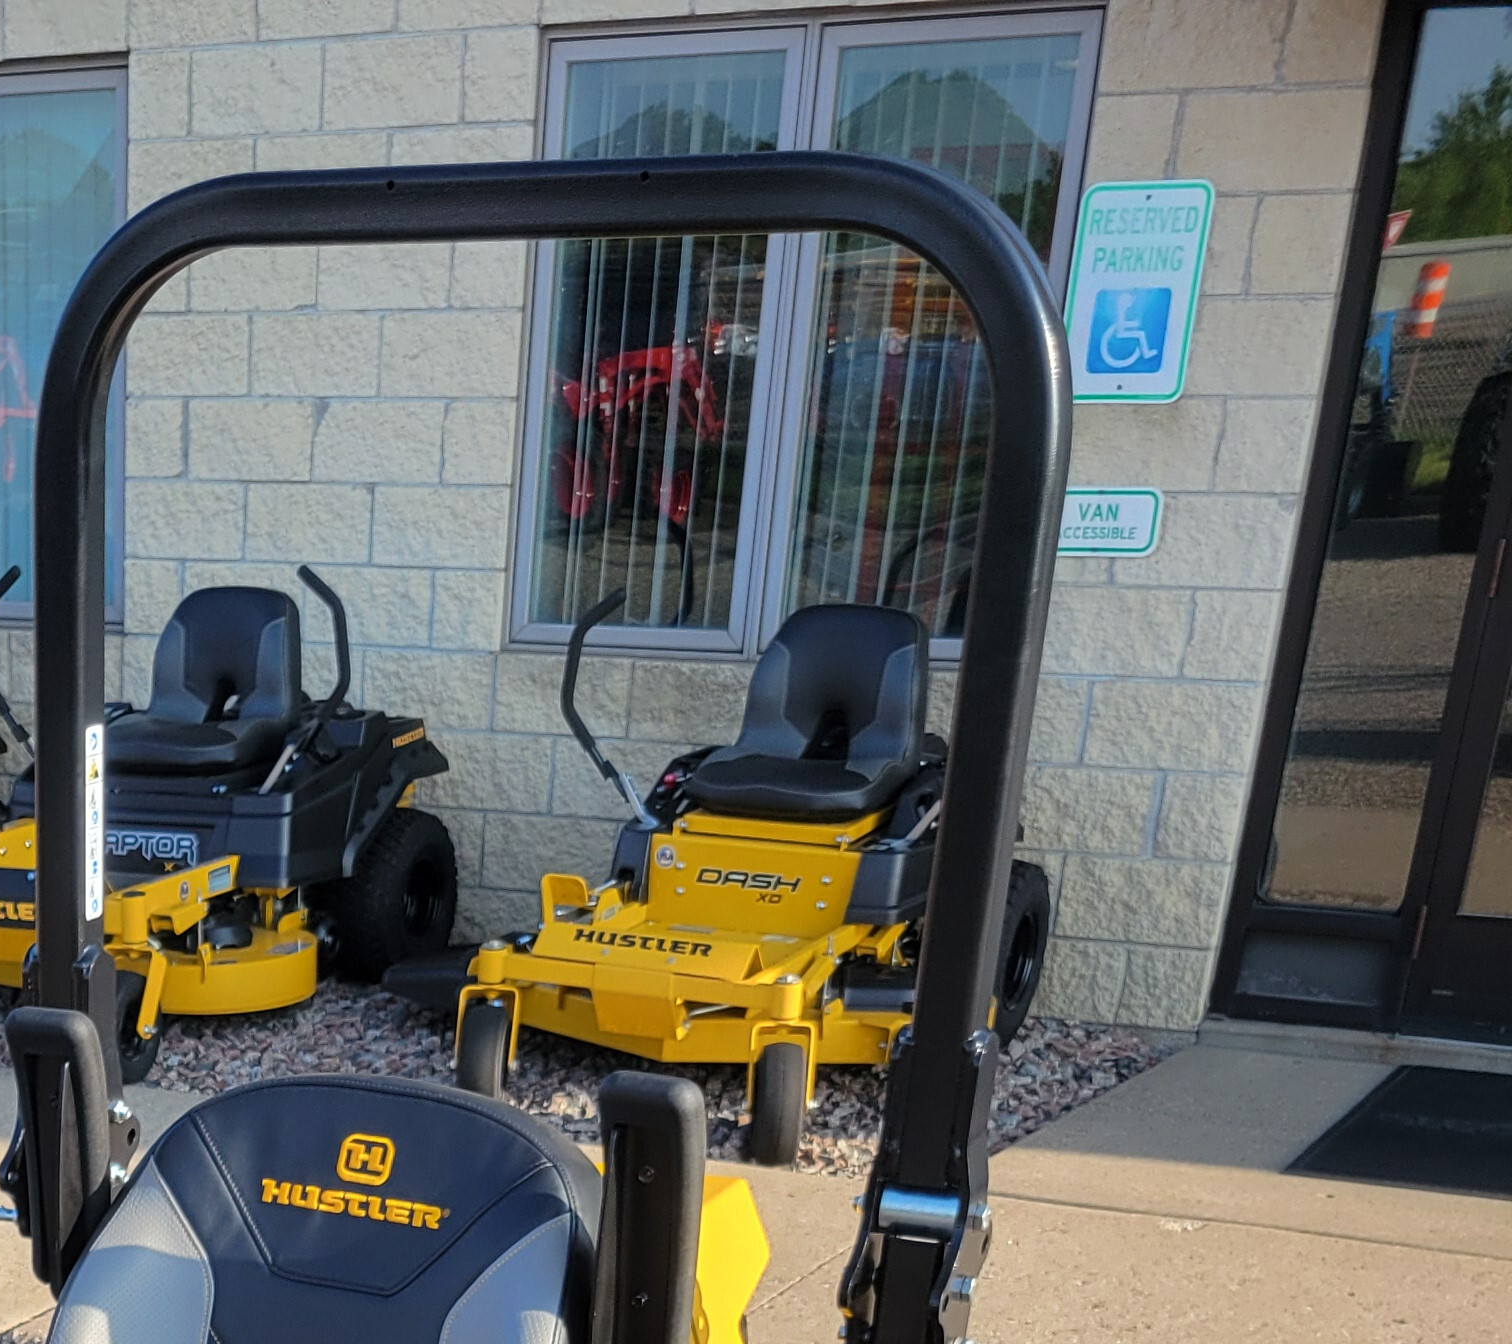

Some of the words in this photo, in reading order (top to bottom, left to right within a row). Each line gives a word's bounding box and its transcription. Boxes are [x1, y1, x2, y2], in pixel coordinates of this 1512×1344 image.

[1089, 206, 1199, 234] RESERVED
[1092, 246, 1185, 272] PARKING
[1078, 503, 1119, 521] VAN
[1061, 527, 1138, 540] CCESSIBLE
[106, 830, 200, 868] APTOR
[696, 868, 802, 893] DASH
[755, 893, 783, 905] XD
[574, 929, 713, 957] HUSTLER
[261, 1177, 443, 1230] HUSTLER
